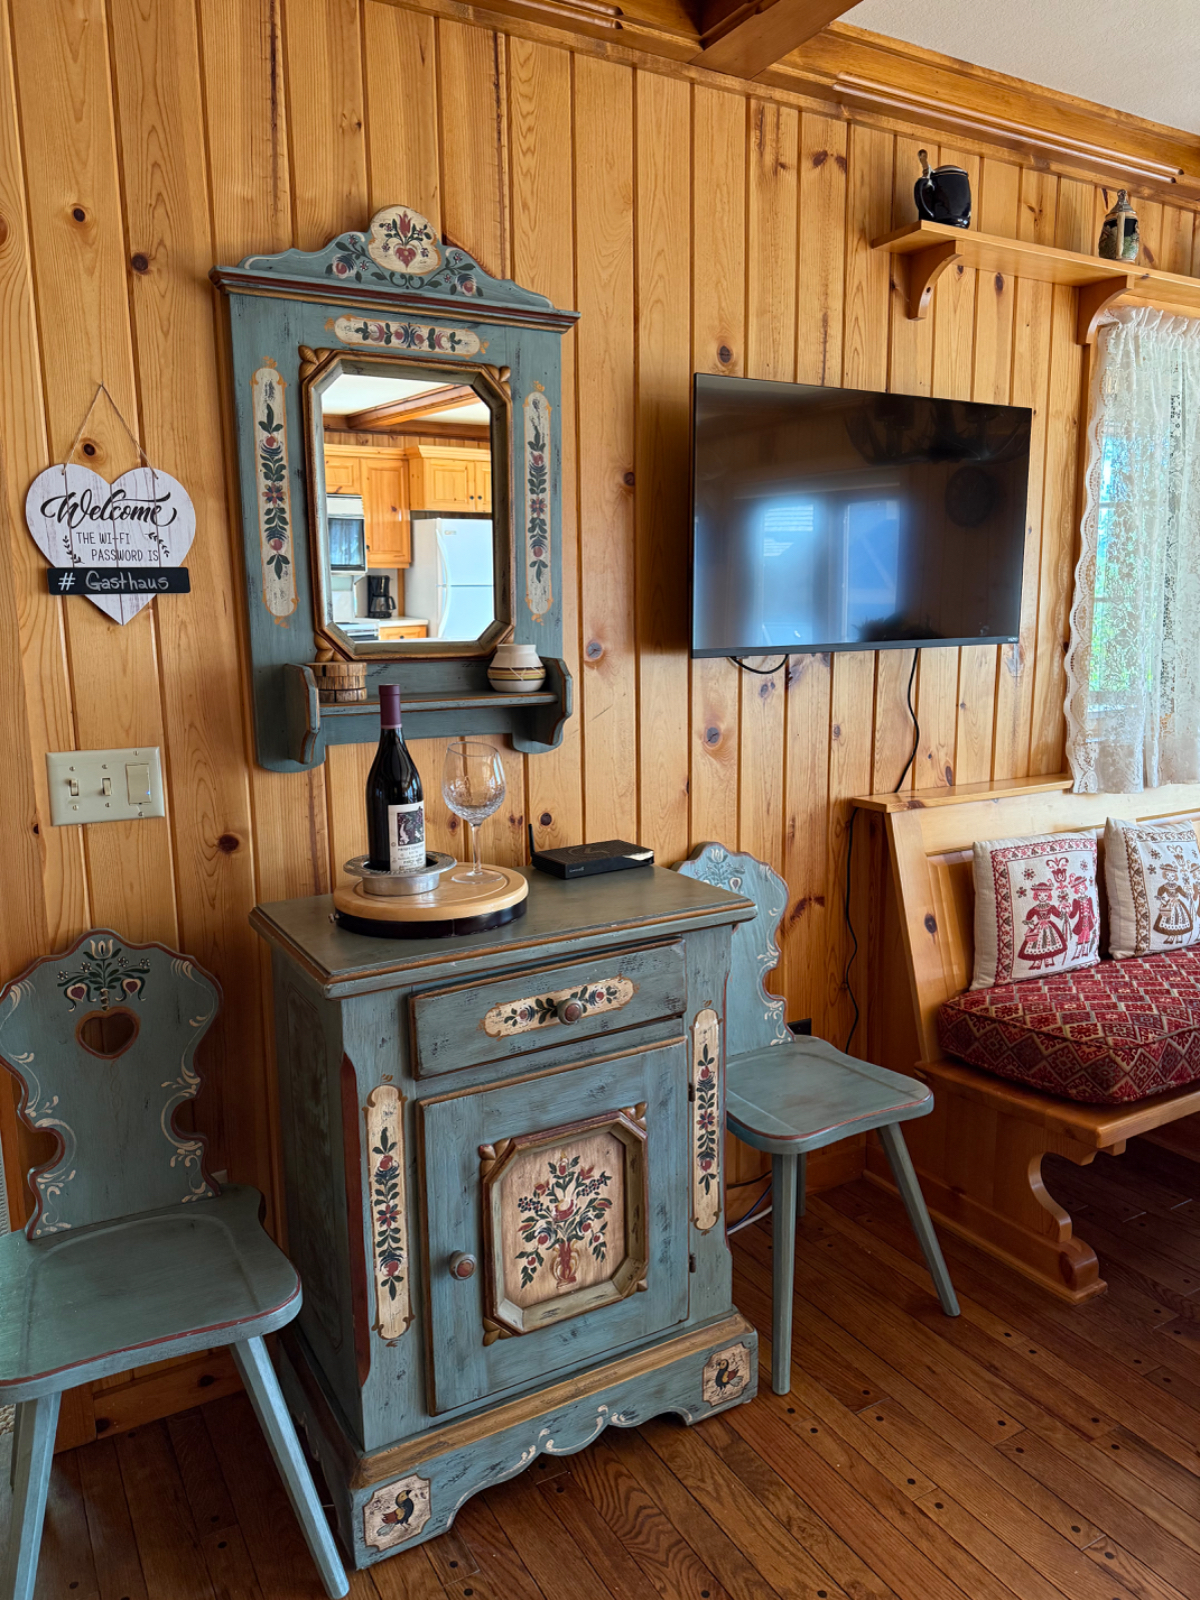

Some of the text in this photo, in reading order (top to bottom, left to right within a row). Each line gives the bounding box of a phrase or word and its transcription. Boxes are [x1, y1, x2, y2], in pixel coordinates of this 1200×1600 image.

[40, 489, 177, 528] Welcome
[76, 532, 131, 545] THE WI-FI
[91, 549, 159, 562] PASSWORD IS
[85, 570, 169, 591] Gasthaus
